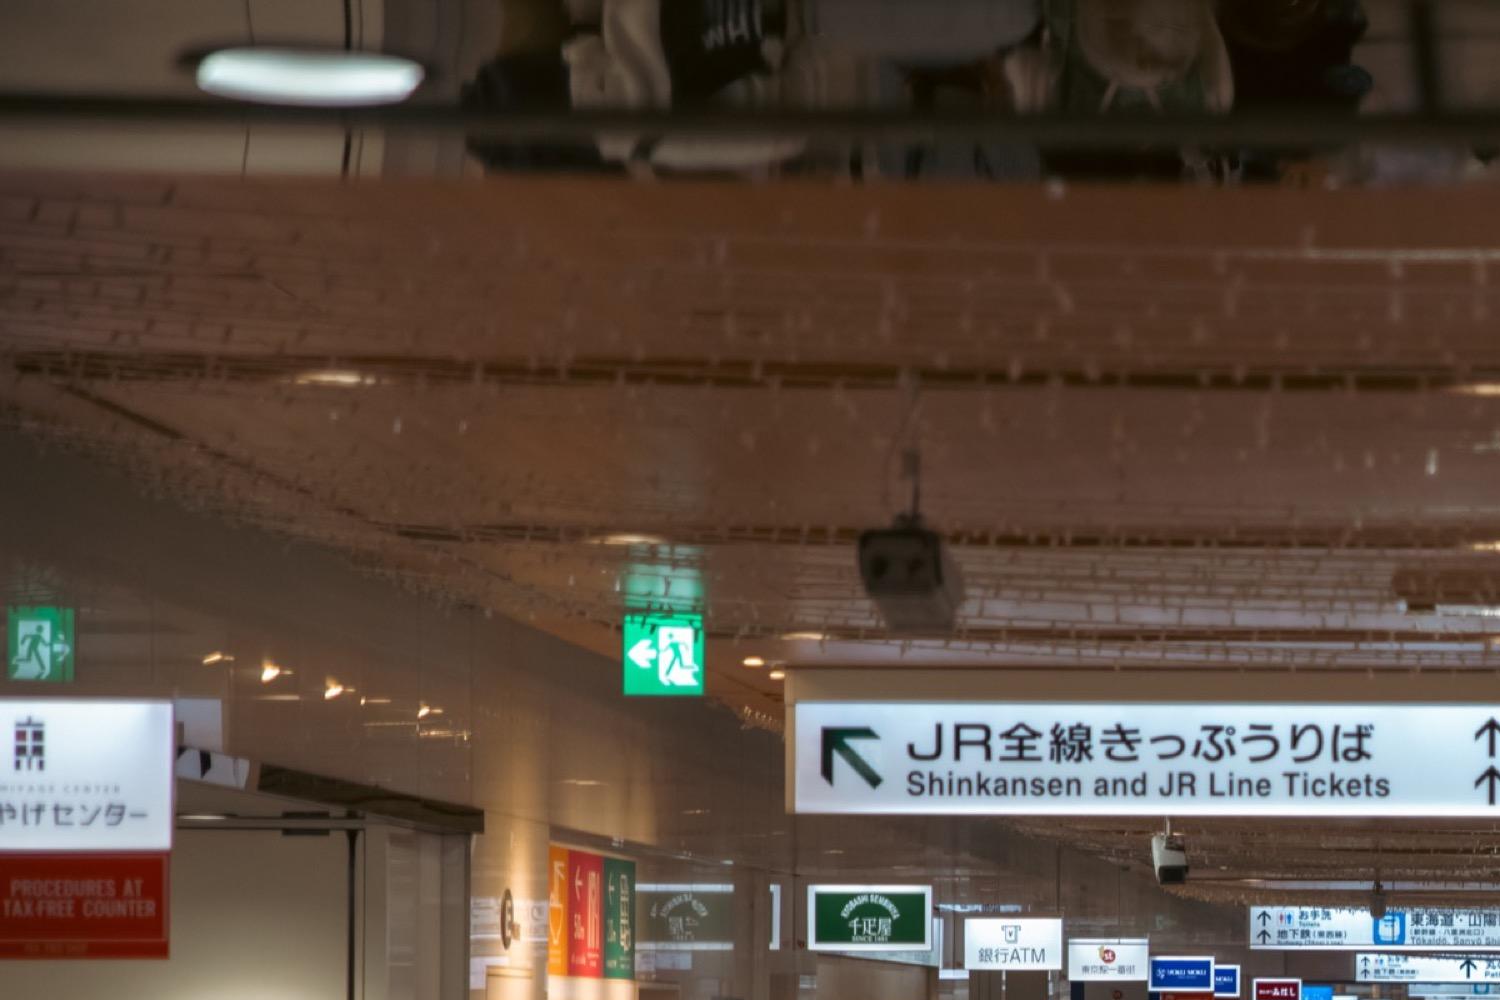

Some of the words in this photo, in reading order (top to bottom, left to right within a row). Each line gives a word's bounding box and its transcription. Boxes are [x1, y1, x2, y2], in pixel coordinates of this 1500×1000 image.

[906, 722, 1375, 765] JR全線きっぷうりば
[906, 772, 1082, 797] Shinkansen
[1094, 772, 1148, 797] and
[1158, 772, 1197, 797] JR
[1209, 772, 1272, 797] Line
[1282, 772, 1391, 797] Tickets
[10, 880, 116, 896] PROCEDURES
[123, 880, 144, 896] AT
[83, 900, 156, 917] COUNTER
[848, 917, 892, 936] 千疋屋
[977, 947, 1046, 964] 銀行ATM
